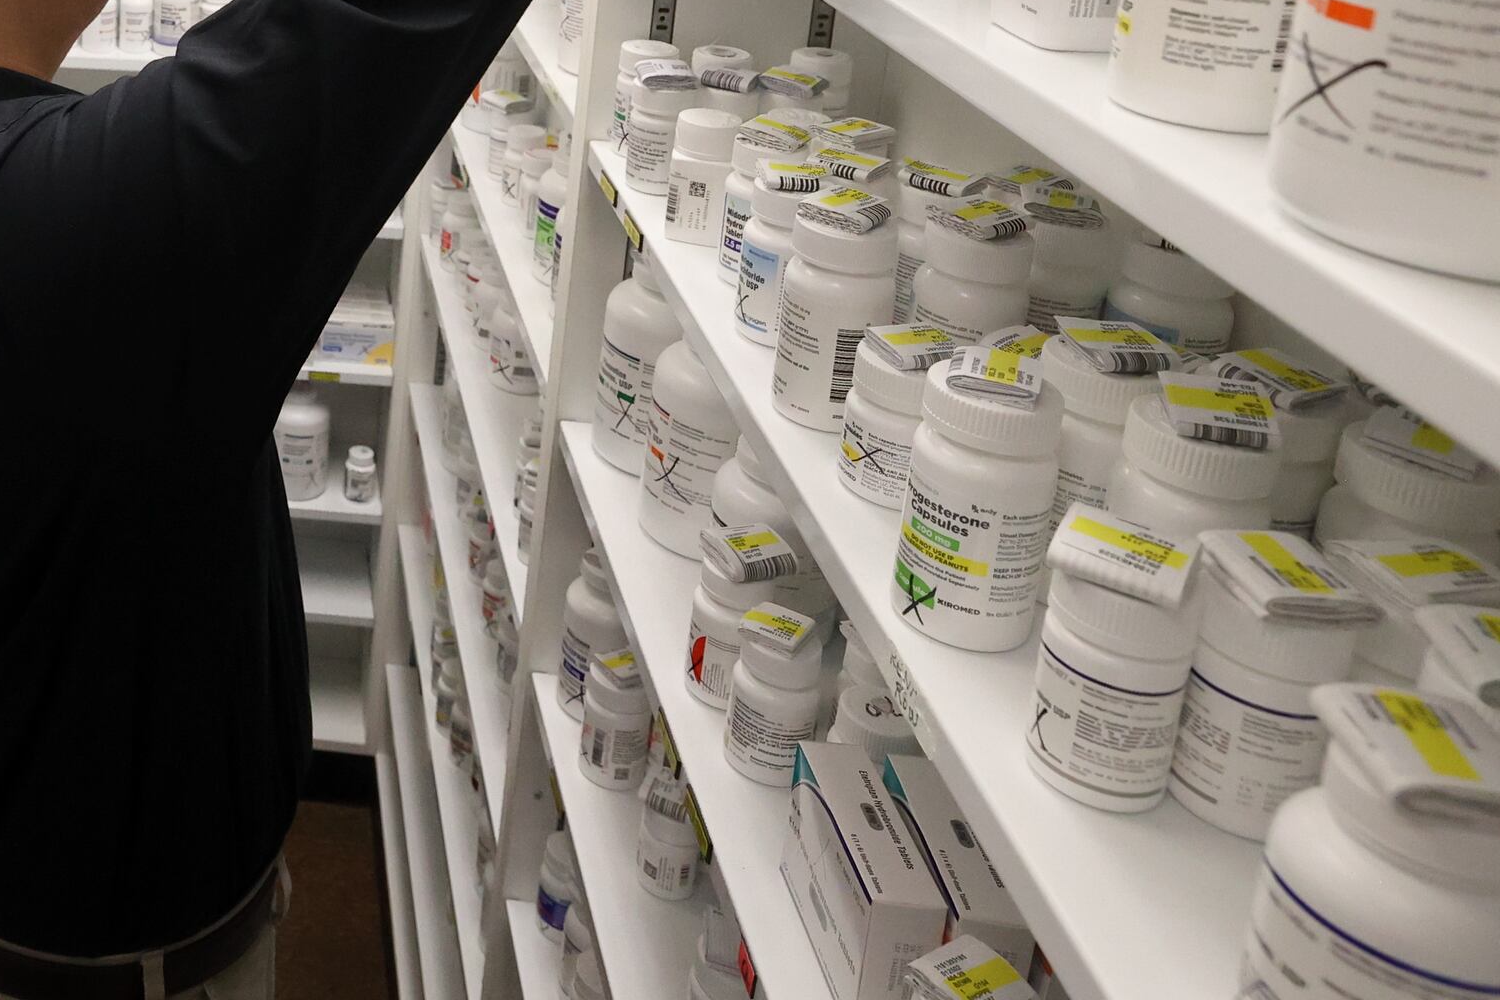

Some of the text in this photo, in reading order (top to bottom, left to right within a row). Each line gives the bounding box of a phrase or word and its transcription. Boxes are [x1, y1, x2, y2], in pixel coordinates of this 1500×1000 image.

[726, 237, 734, 248] 2.5
[746, 280, 759, 291] USP
[619, 381, 633, 390] USP
[911, 499, 969, 537] Capsules
[981, 508, 998, 516] only
[916, 521, 951, 547] 200 mg
[919, 538, 931, 550] NOT
[933, 546, 946, 557] USE
[925, 550, 969, 572] TO PEANUTS
[937, 598, 981, 616] XIROMED
[860, 769, 914, 871] Eletriptan Hydrobromide Tablets
